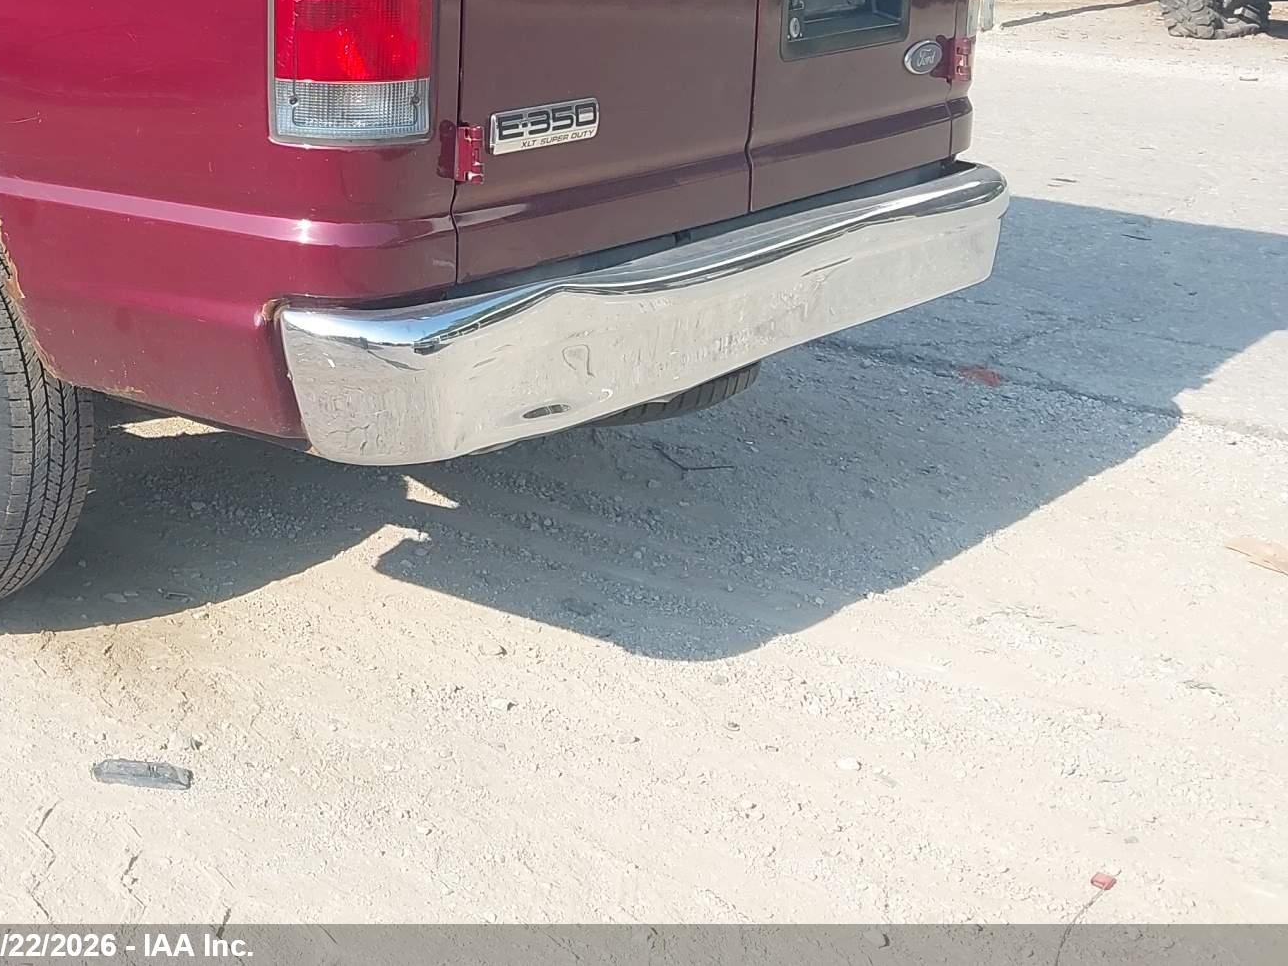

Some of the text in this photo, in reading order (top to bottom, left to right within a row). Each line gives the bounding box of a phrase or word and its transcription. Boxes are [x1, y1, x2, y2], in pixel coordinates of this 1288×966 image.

[917, 49, 936, 67] Ford
[497, 102, 597, 140] E-350
[521, 129, 595, 149] XLT SUPER DUTY
